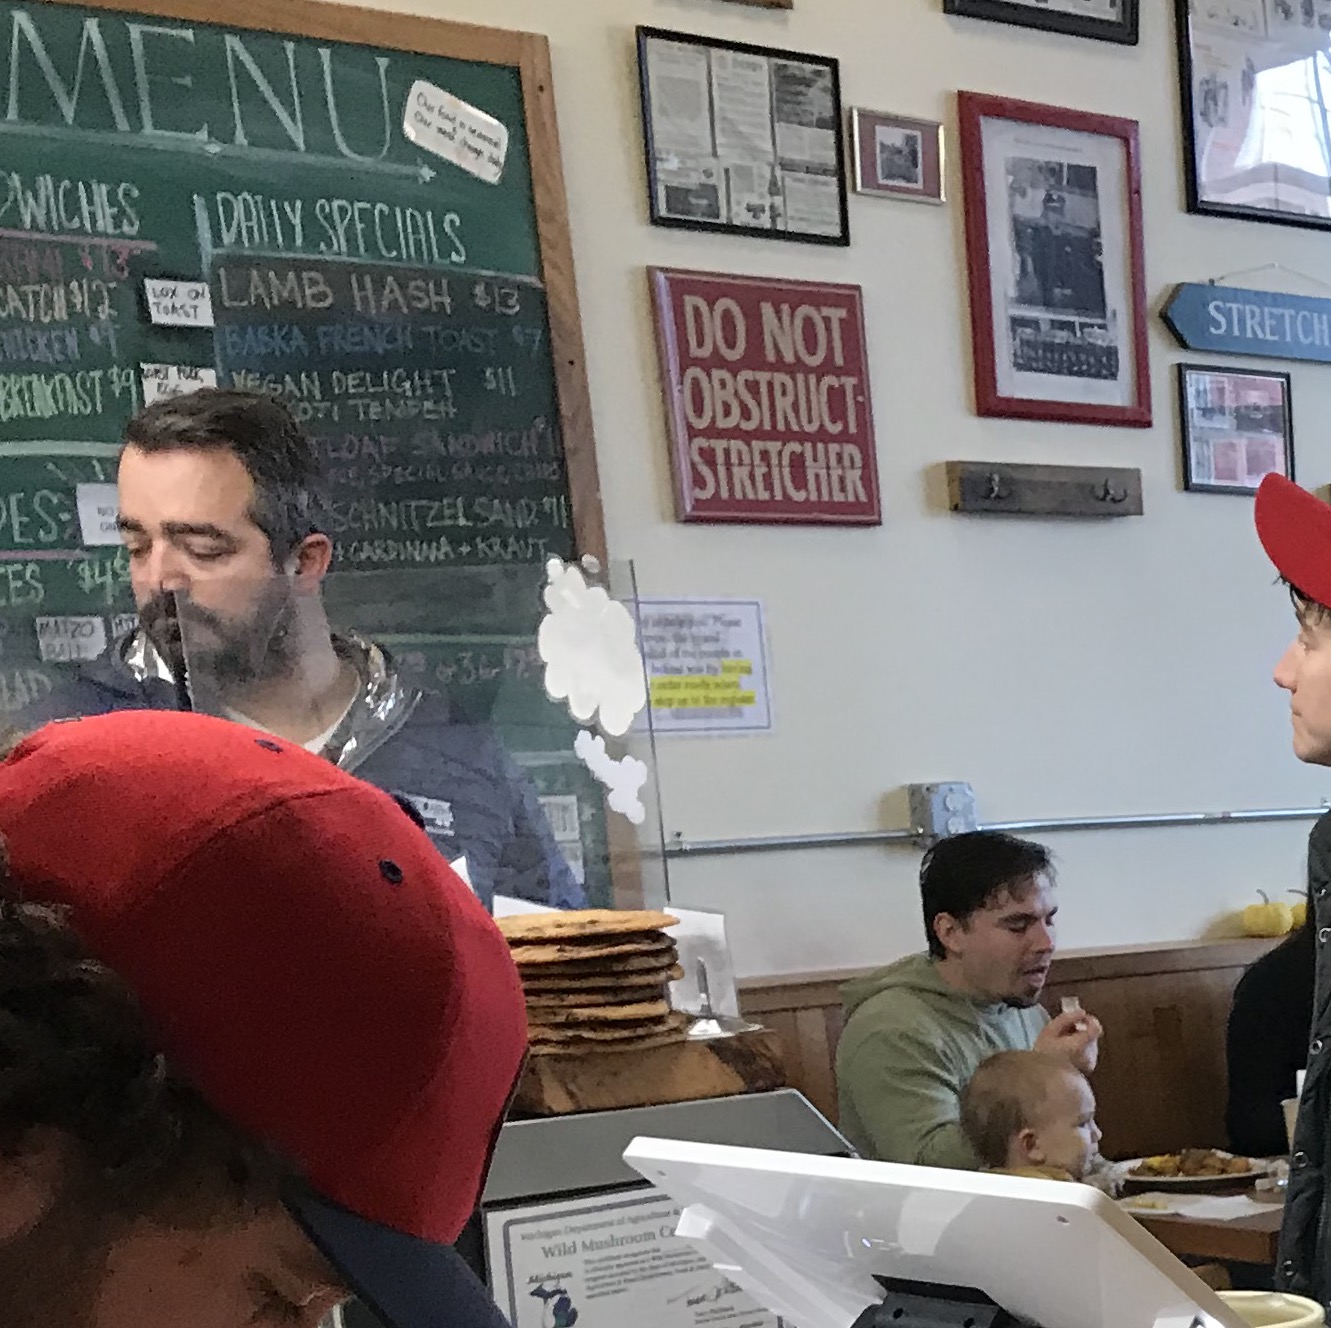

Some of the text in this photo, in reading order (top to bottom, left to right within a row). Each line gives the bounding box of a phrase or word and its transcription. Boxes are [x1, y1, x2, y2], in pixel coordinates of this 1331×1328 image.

[6, 10, 391, 163] MENU
[216, 191, 467, 265] DAILY SPECIALS
[217, 266, 334, 311] LAMB
[350, 271, 452, 316] HASH
[683, 294, 848, 368] DO NOT
[231, 367, 322, 400] VEGAN
[331, 366, 456, 398] DELIGHT
[683, 365, 858, 435] OBSTRUCT
[690, 436, 869, 503] STRETCHER
[541, 1240, 578, 1260] Wild
[581, 1227, 657, 1252] Mushroom
